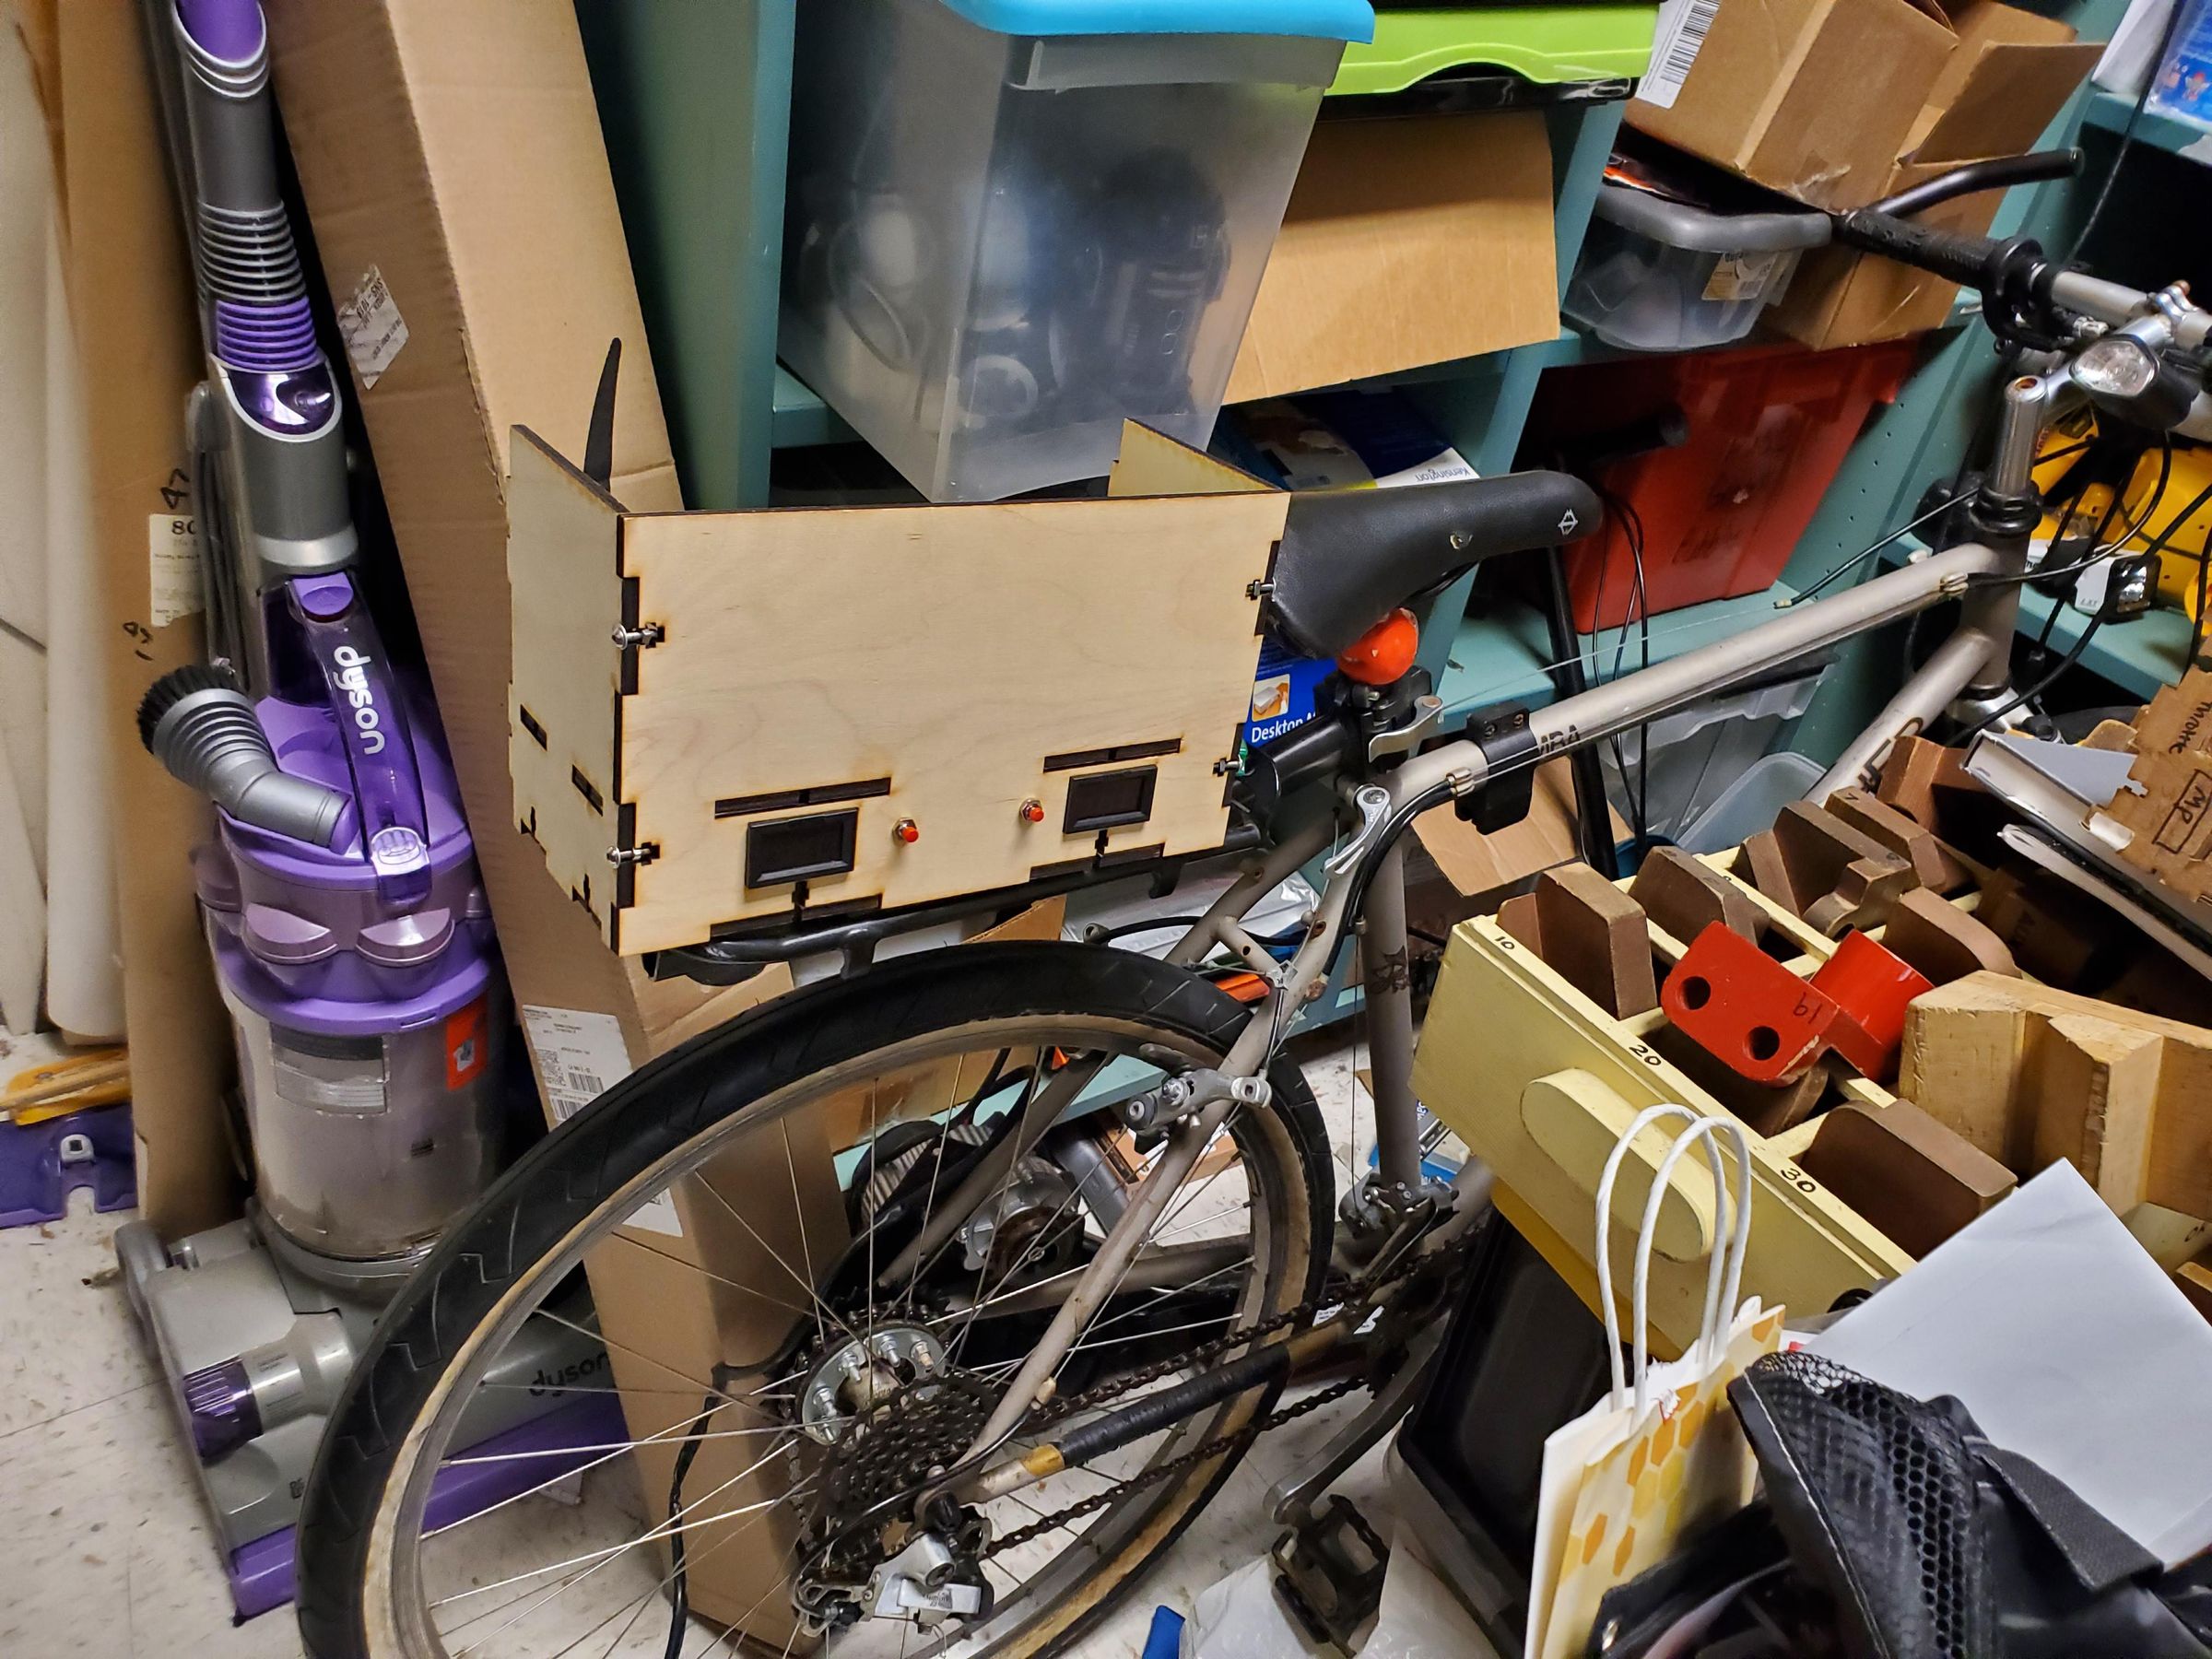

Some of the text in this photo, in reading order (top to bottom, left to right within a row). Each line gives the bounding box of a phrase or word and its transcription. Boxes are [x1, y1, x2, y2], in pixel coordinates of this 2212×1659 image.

[1415, 466, 1471, 482] Kensington
[333, 645, 385, 755] dyson
[1494, 935, 1516, 950] 10
[1629, 1044, 1662, 1066] 20
[1781, 1168, 1817, 1193] 30
